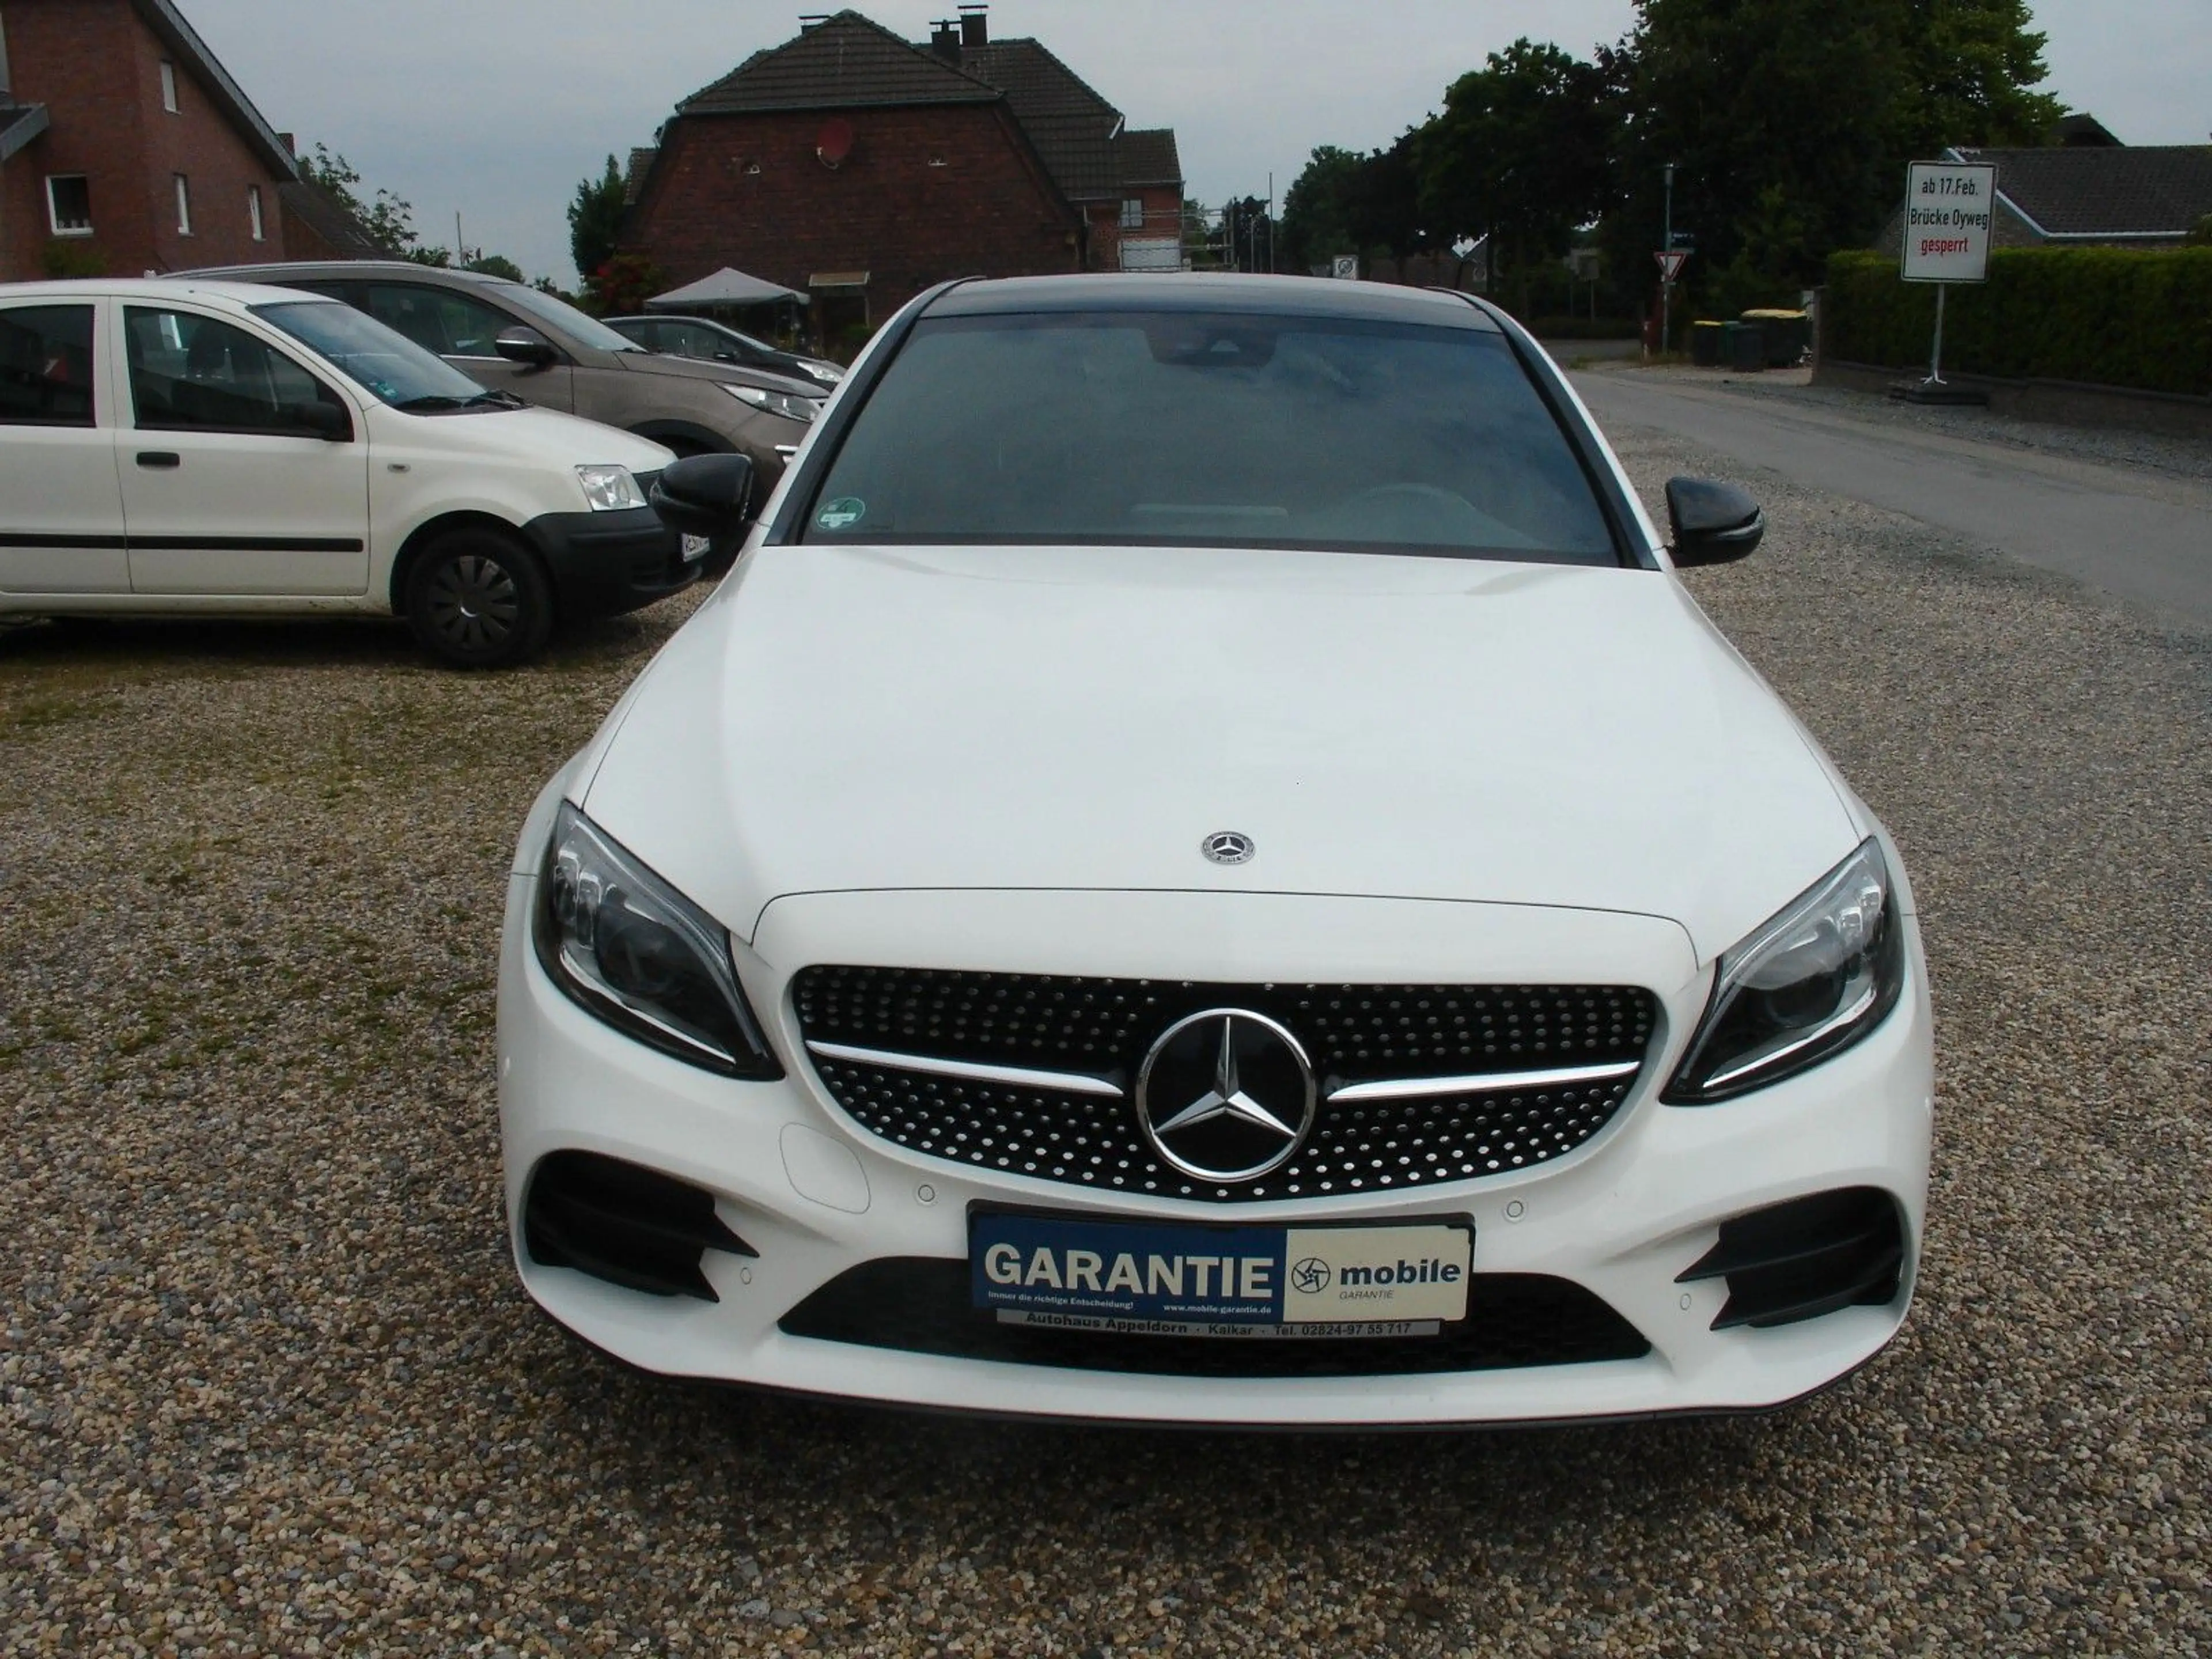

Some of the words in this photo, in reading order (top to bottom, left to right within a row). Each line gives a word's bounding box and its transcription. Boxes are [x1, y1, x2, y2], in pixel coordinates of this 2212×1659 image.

[1922, 177, 1935, 194] ab
[1910, 209, 1949, 225] Brücke
[1952, 209, 1988, 230] Oyweg
[1921, 237, 1968, 256] gesperrt
[985, 1243, 1274, 1298] GARANTIE
[1340, 1259, 1461, 1285] mobile
[988, 1290, 1016, 1300] Immer
[1018, 1293, 1032, 1301] die
[1034, 1294, 1068, 1305] richtige
[1070, 1297, 1134, 1310] Entscheidung!
[1339, 1290, 1395, 1300] GARANTIE
[1027, 1312, 1100, 1328] Autohaus
[1105, 1318, 1187, 1333] Appeldorn
[1209, 1324, 1253, 1335] Kalkar
[1275, 1325, 1297, 1335] Tel.
[1388, 1324, 1411, 1335] 717
